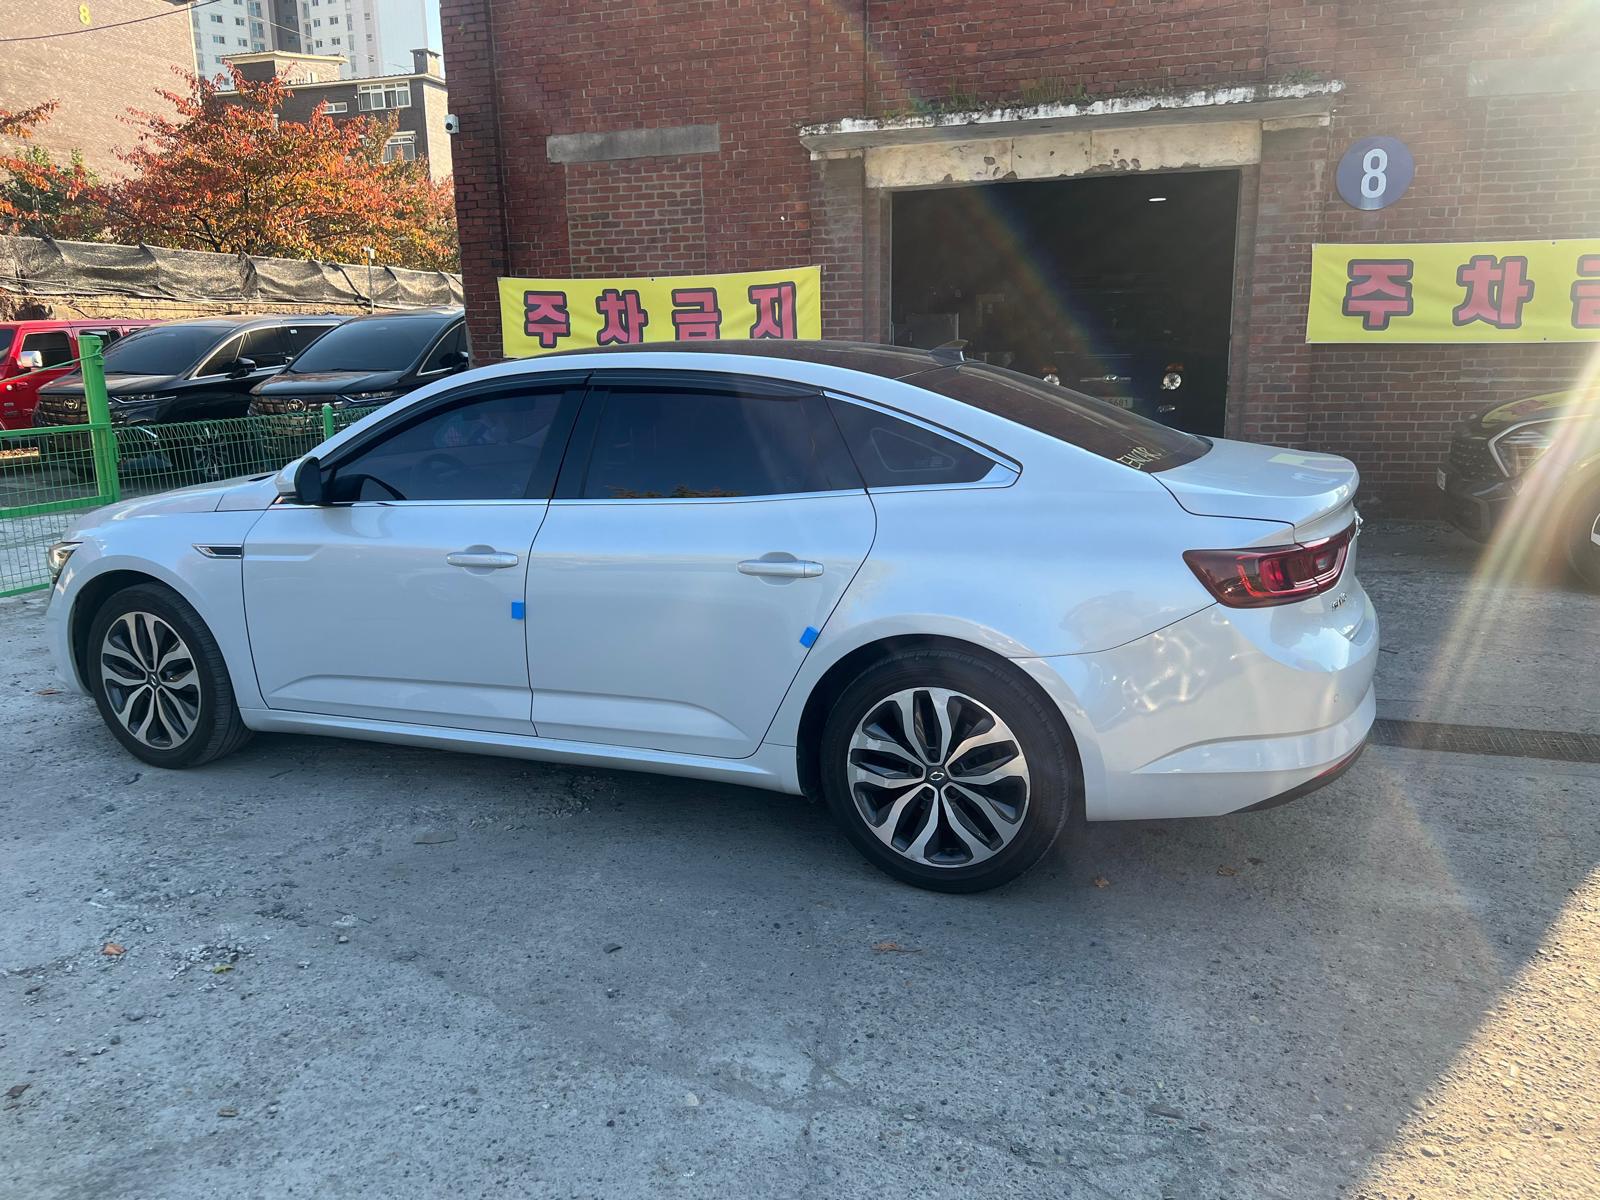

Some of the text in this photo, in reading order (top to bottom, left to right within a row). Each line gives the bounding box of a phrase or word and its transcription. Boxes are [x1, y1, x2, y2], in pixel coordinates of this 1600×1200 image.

[79, 4, 91, 26] 8
[1361, 149, 1388, 198] 8
[524, 281, 798, 349] 주차금지
